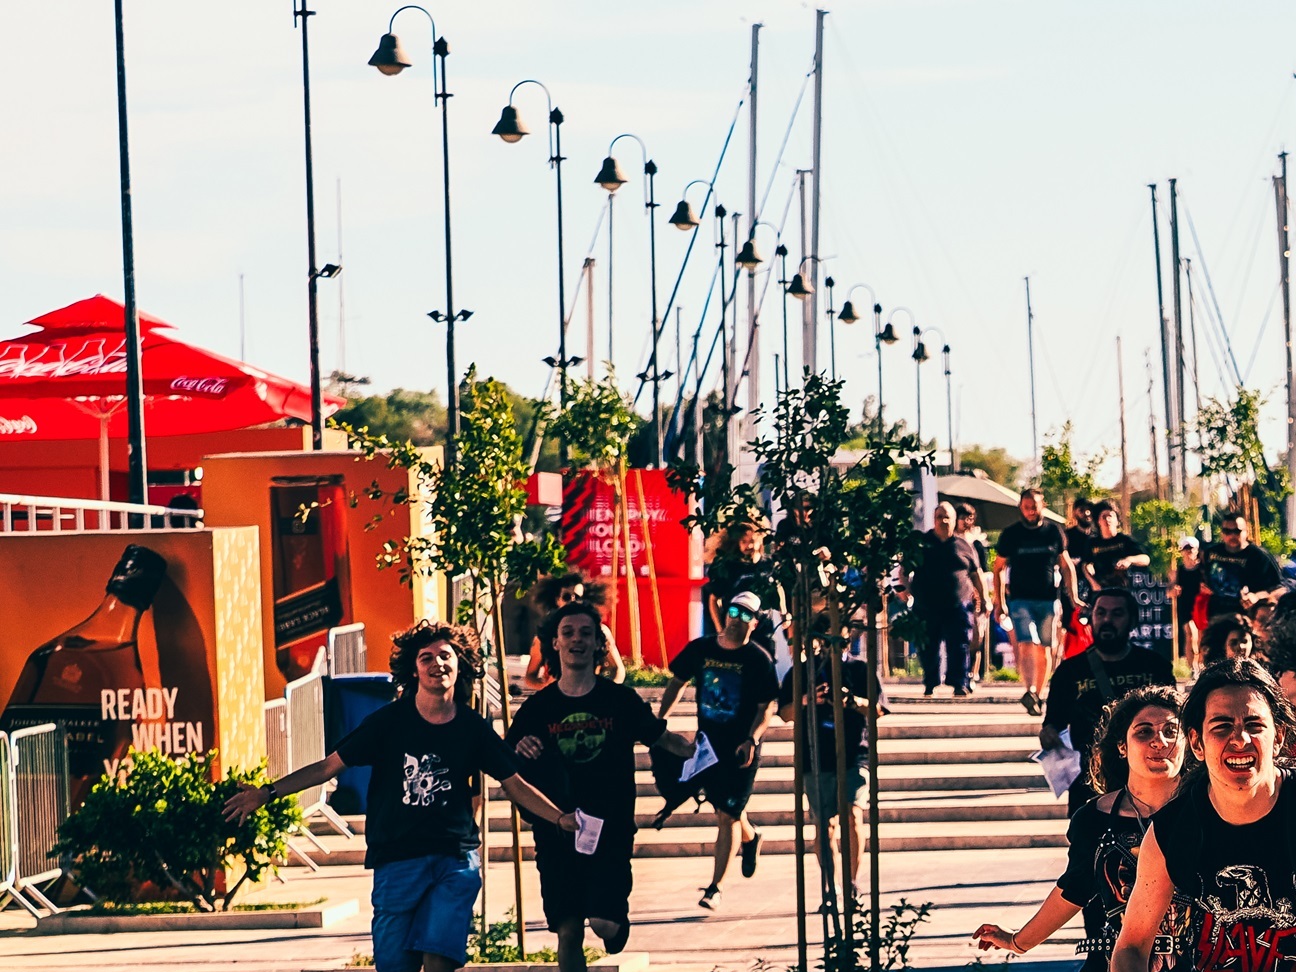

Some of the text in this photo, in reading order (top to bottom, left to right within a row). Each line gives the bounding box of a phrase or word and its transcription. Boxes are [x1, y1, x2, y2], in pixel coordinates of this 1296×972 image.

[101, 686, 178, 720] READY
[1075, 672, 1154, 700] MEADETH
[132, 720, 203, 754] WHEN
